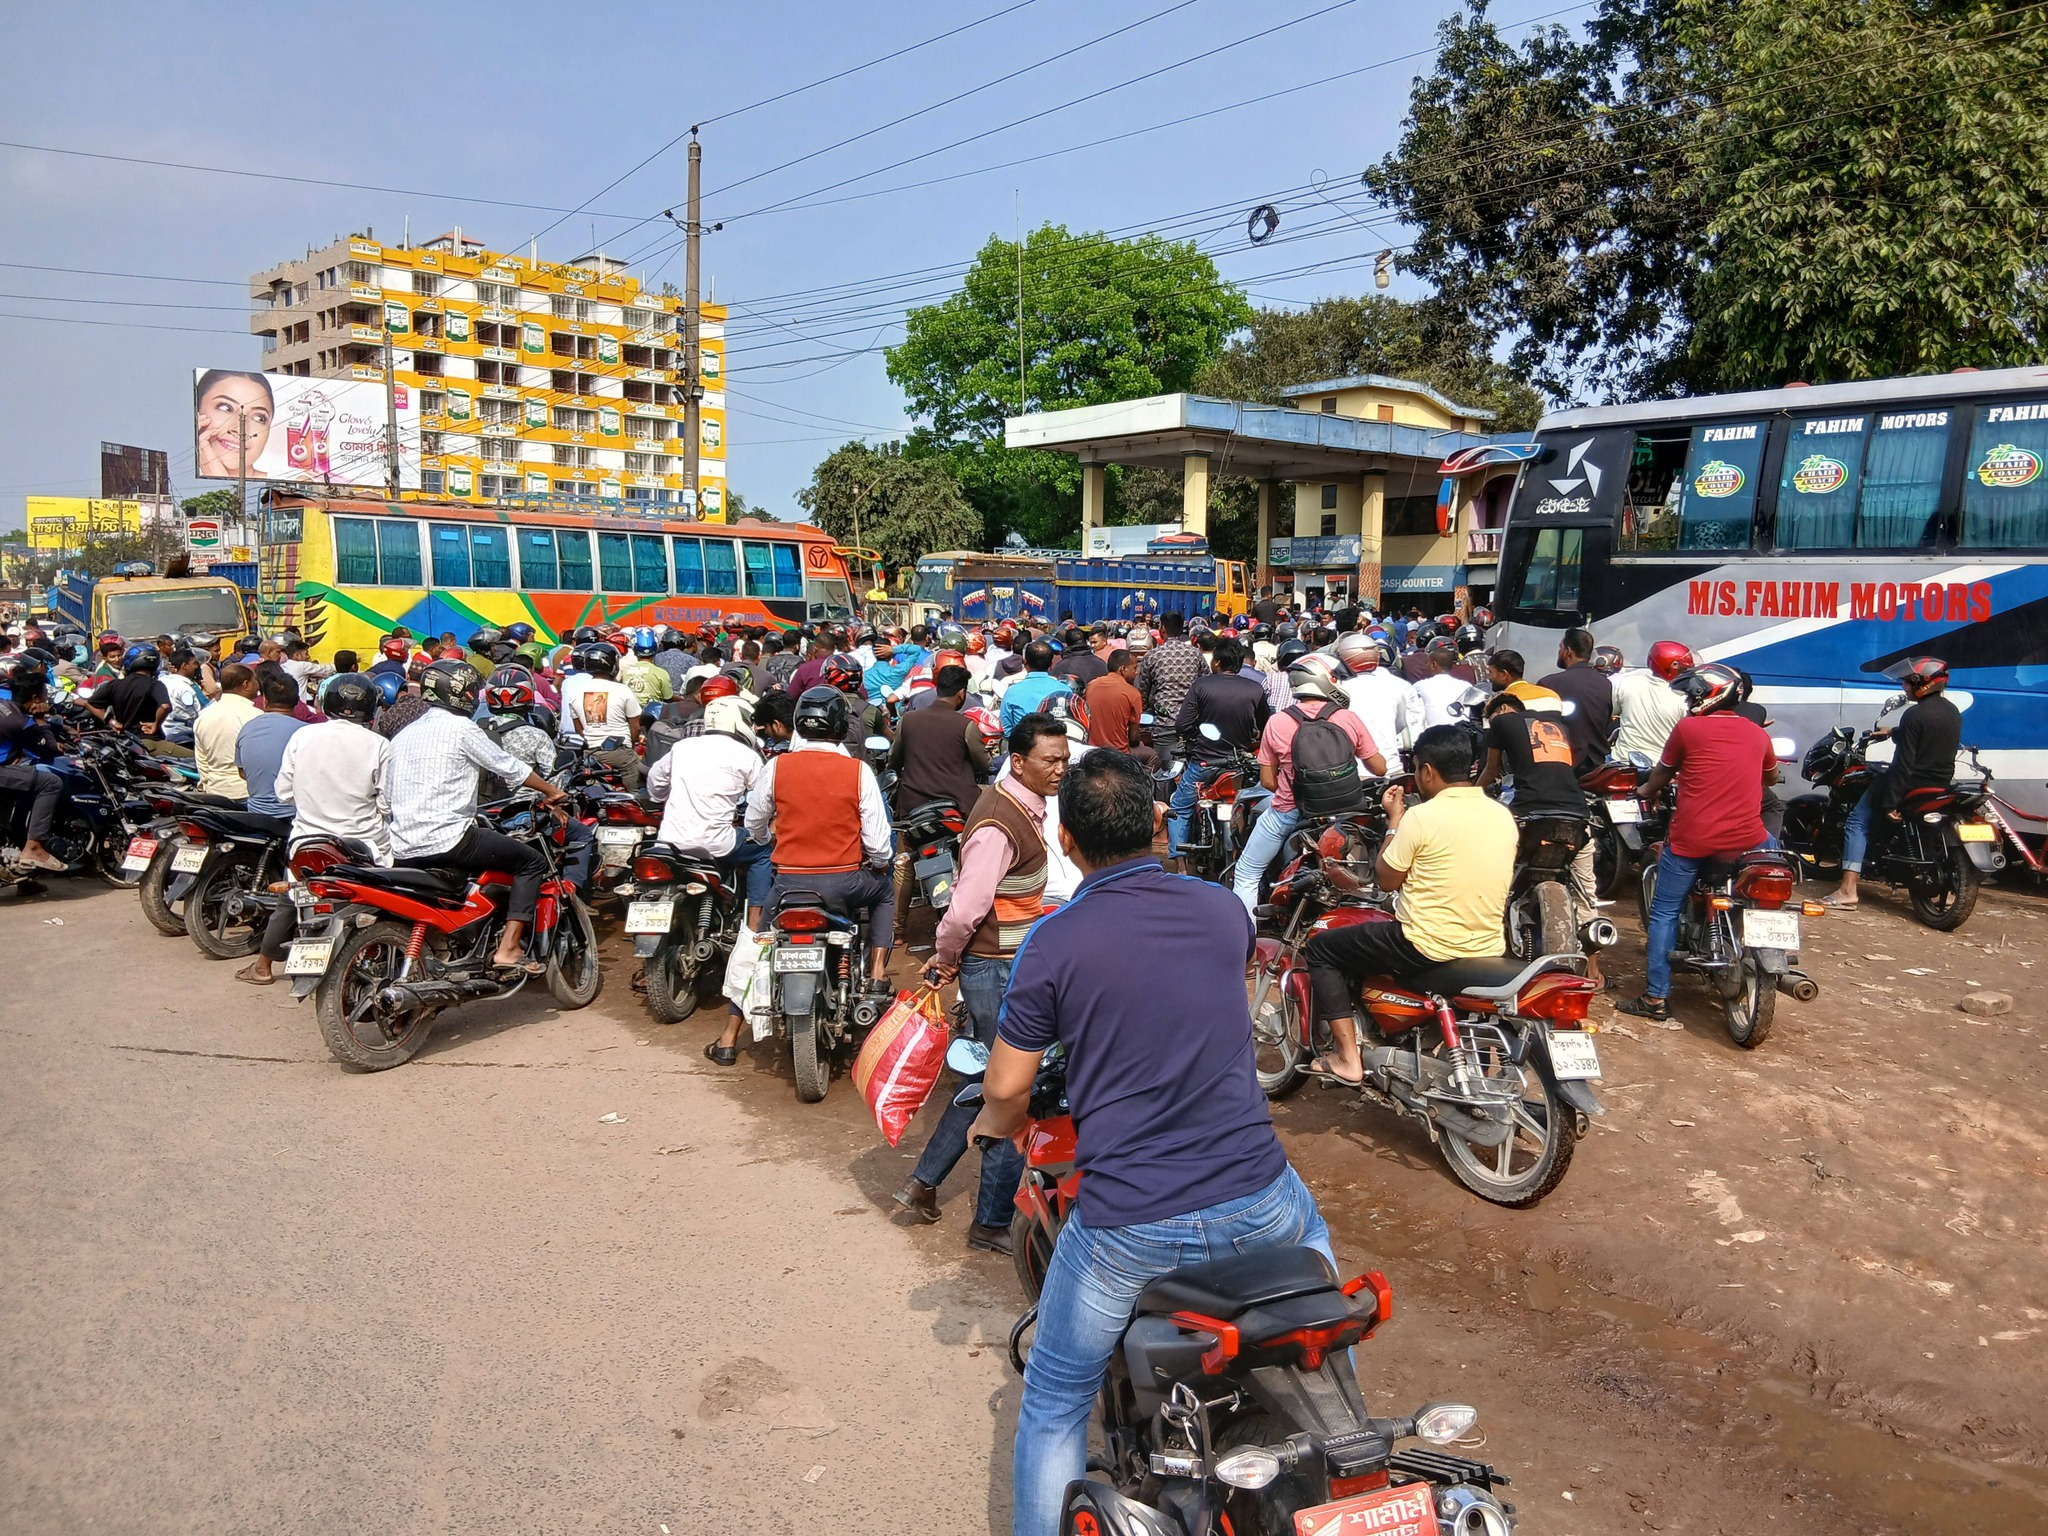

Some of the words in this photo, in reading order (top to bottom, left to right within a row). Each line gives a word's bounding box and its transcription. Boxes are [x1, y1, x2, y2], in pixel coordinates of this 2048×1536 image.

[1804, 418, 1864, 435] FAHIM
[1880, 412, 1948, 430] MOTORS
[1703, 425, 1758, 442] FAHIM
[1269, 547, 1290, 558] যমুনা
[1382, 579, 1401, 588] CASH
[1402, 577, 1444, 588] COUNTER
[1687, 581, 1838, 619] M/S.FAHIM
[1849, 581, 1993, 623] MOTORS
[1381, 993, 1396, 1002] CD
[1324, 1431, 1378, 1445] HONDA
[1346, 1497, 1428, 1530] শামীম
